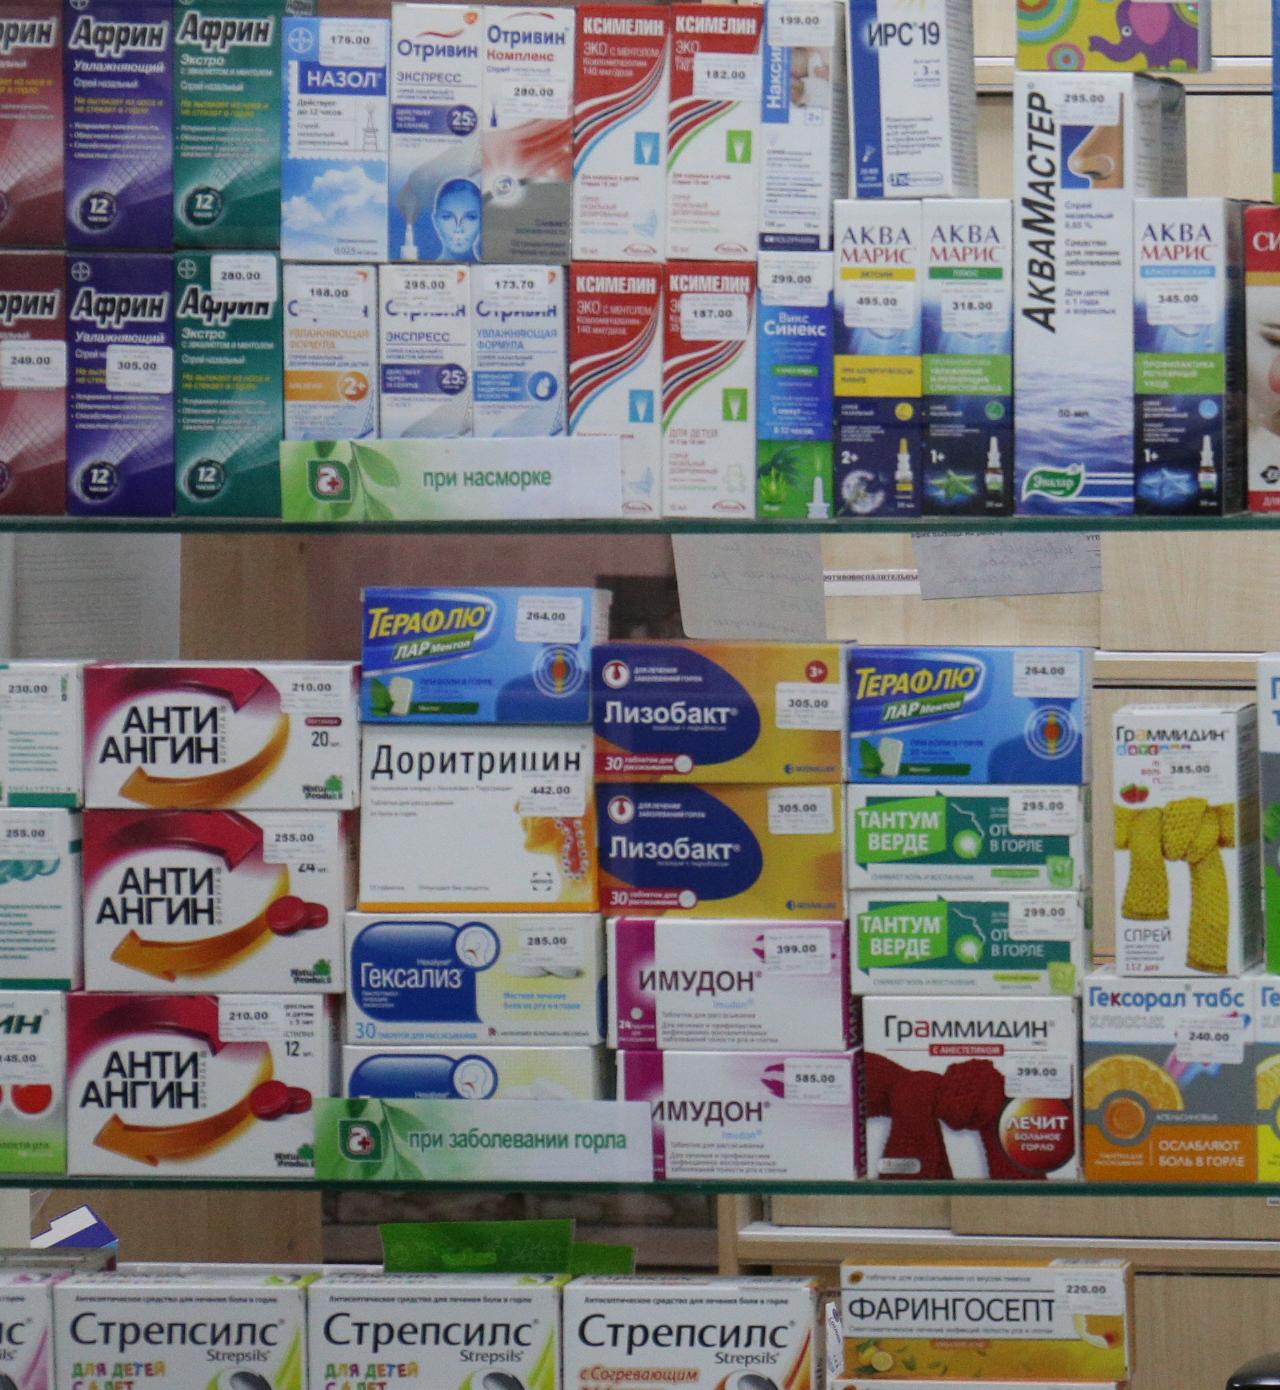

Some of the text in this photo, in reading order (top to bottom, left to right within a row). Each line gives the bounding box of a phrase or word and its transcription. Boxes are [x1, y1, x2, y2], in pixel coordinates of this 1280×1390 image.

[583, 18, 664, 37] КСИМЕЛИН
[675, 15, 757, 35] КСИМЕЛИН
[778, 15, 820, 25] 199.00
[71, 20, 166, 57] Африн
[178, 13, 273, 52] Африн
[487, 25, 567, 48] Отривин
[867, 22, 940, 46] ИРС 19
[396, 39, 478, 60] Отривин
[486, 49, 555, 63] Комплекс
[675, 39, 700, 54] ЭКО
[73, 60, 165, 76] Увлажняющий
[397, 71, 463, 84] ЭКСПРЕСС
[705, 70, 746, 80] 182.00
[306, 71, 378, 89] НАЗОЛ
[90, 198, 110, 214] 12
[196, 195, 214, 210] 12
[1021, 90, 1057, 334] АКВАМАСТЕР
[841, 226, 912, 245] АКВА
[930, 224, 1001, 244] АКВА
[1142, 223, 1212, 242] АКВА
[840, 246, 912, 264] МАРИС
[930, 244, 998, 263] МАРИС
[1140, 243, 1213, 262] МАРИС
[494, 279, 535, 290] 173.70
[576, 276, 658, 295] КСИМЕЛИН
[669, 274, 751, 294] КСИМЕЛИН
[71, 291, 167, 327] Африн
[778, 312, 810, 325] Викс
[75, 331, 166, 344] Увлажняющий
[386, 331, 451, 343] ЭКСПРЕСС
[476, 328, 558, 341] УВЛАЖНЯЮЩАЯ
[763, 321, 827, 338] Синекс
[476, 339, 525, 351] ФОРМУЛА
[343, 376, 366, 395] 2+
[840, 450, 859, 464] 2+
[91, 468, 110, 484] 12
[198, 467, 216, 483] 12
[423, 467, 553, 492] при насморке
[367, 605, 487, 640] ТЕРАФЛЮ
[393, 642, 432, 661] ЛАР
[855, 666, 978, 701] ТЕРАФЛЮ
[122, 706, 219, 735] АНТИ
[603, 700, 732, 725] Лизобакт
[883, 702, 921, 721] ЛАР
[311, 730, 329, 748] 20
[1116, 726, 1226, 743] Граммидин
[99, 736, 219, 764] АНГИН
[370, 744, 582, 781] Доритрицин
[857, 809, 940, 829] ТАНТУМ
[990, 825, 1008, 838] ОТ
[608, 836, 734, 860] Лизобакт
[867, 832, 930, 852] ВЕРДЕ
[990, 839, 1044, 853] В ГОРЛЕ
[118, 867, 214, 896] АНТИ
[96, 897, 215, 925] АНГИН
[860, 914, 943, 934] ТАНТУМ
[990, 930, 1008, 942] ОТ
[1123, 928, 1172, 943] СПРЕЙ
[869, 937, 932, 956] ВЕРДЕ
[991, 944, 1045, 957] В ГОРЛЕ
[359, 962, 462, 990] Гексализ
[638, 970, 755, 995] ИМУДОН
[1088, 986, 1245, 1012] Гексорал табс
[884, 1015, 1049, 1042] Граммидин
[284, 1040, 300, 1057] 12
[102, 1050, 199, 1079] АНТИ
[79, 1079, 200, 1109] АНГИН
[650, 1100, 764, 1125] ИМУДОН
[1005, 1115, 1069, 1130] ЛЕЧИТ
[408, 1127, 627, 1152] при заболевании горла
[1158, 1140, 1241, 1151] ОСЛАБЛЯЮТ
[1159, 1156, 1193, 1168] БОЛЬ
[1195, 1156, 1204, 1167] В
[1206, 1156, 1246, 1168] ГОРЛЕ
[848, 1297, 1055, 1322] ФАРИНГОСЕПТ
[70, 1312, 279, 1352] Стрепсилс
[323, 1312, 533, 1353] Стрепсилс
[578, 1313, 789, 1356] Стрепсилс
[206, 1349, 269, 1364] Strepsils
[459, 1350, 522, 1364] Strepsils
[714, 1351, 777, 1367] Strepsils
[71, 1359, 168, 1378] ДЛЯ ДЕТЕЙ
[324, 1361, 420, 1379] ДЛЯ ДЕТЕЙ
[590, 1366, 699, 1384] Согревающим
